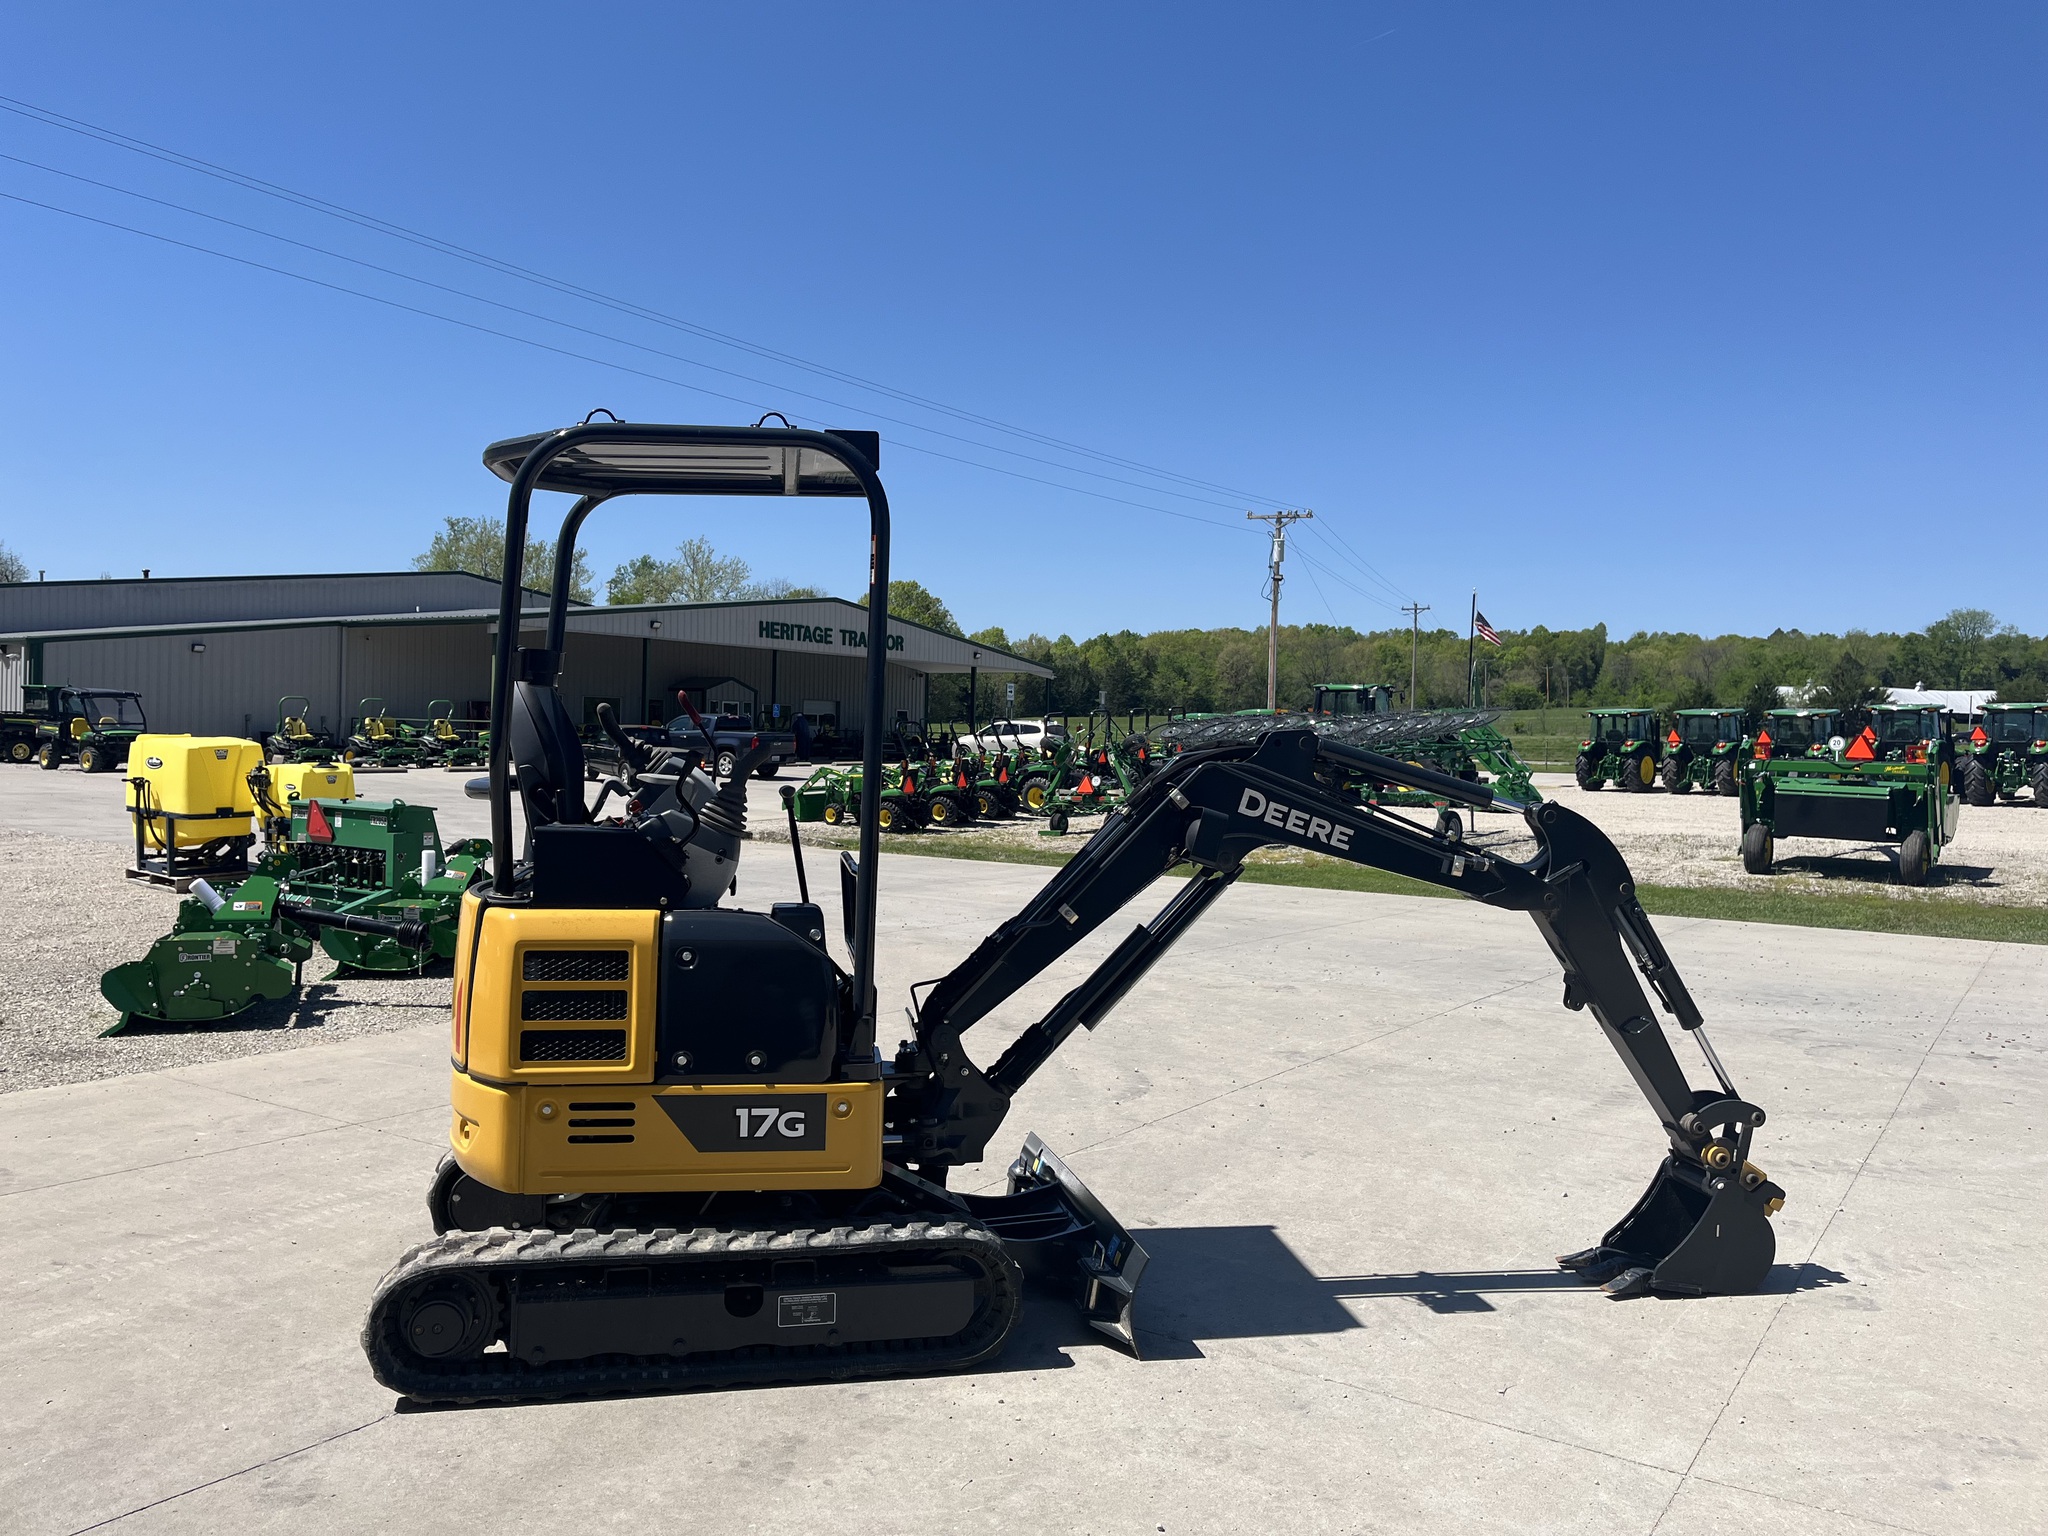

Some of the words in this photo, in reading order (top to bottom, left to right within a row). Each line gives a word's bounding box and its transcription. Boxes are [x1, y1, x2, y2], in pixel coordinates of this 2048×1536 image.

[759, 620, 833, 645] HERITAGE
[839, 629, 904, 651] TRAOR
[1237, 788, 1355, 851] DEERE
[180, 953, 211, 962] FRONTIER
[736, 1108, 805, 1138] 17G
